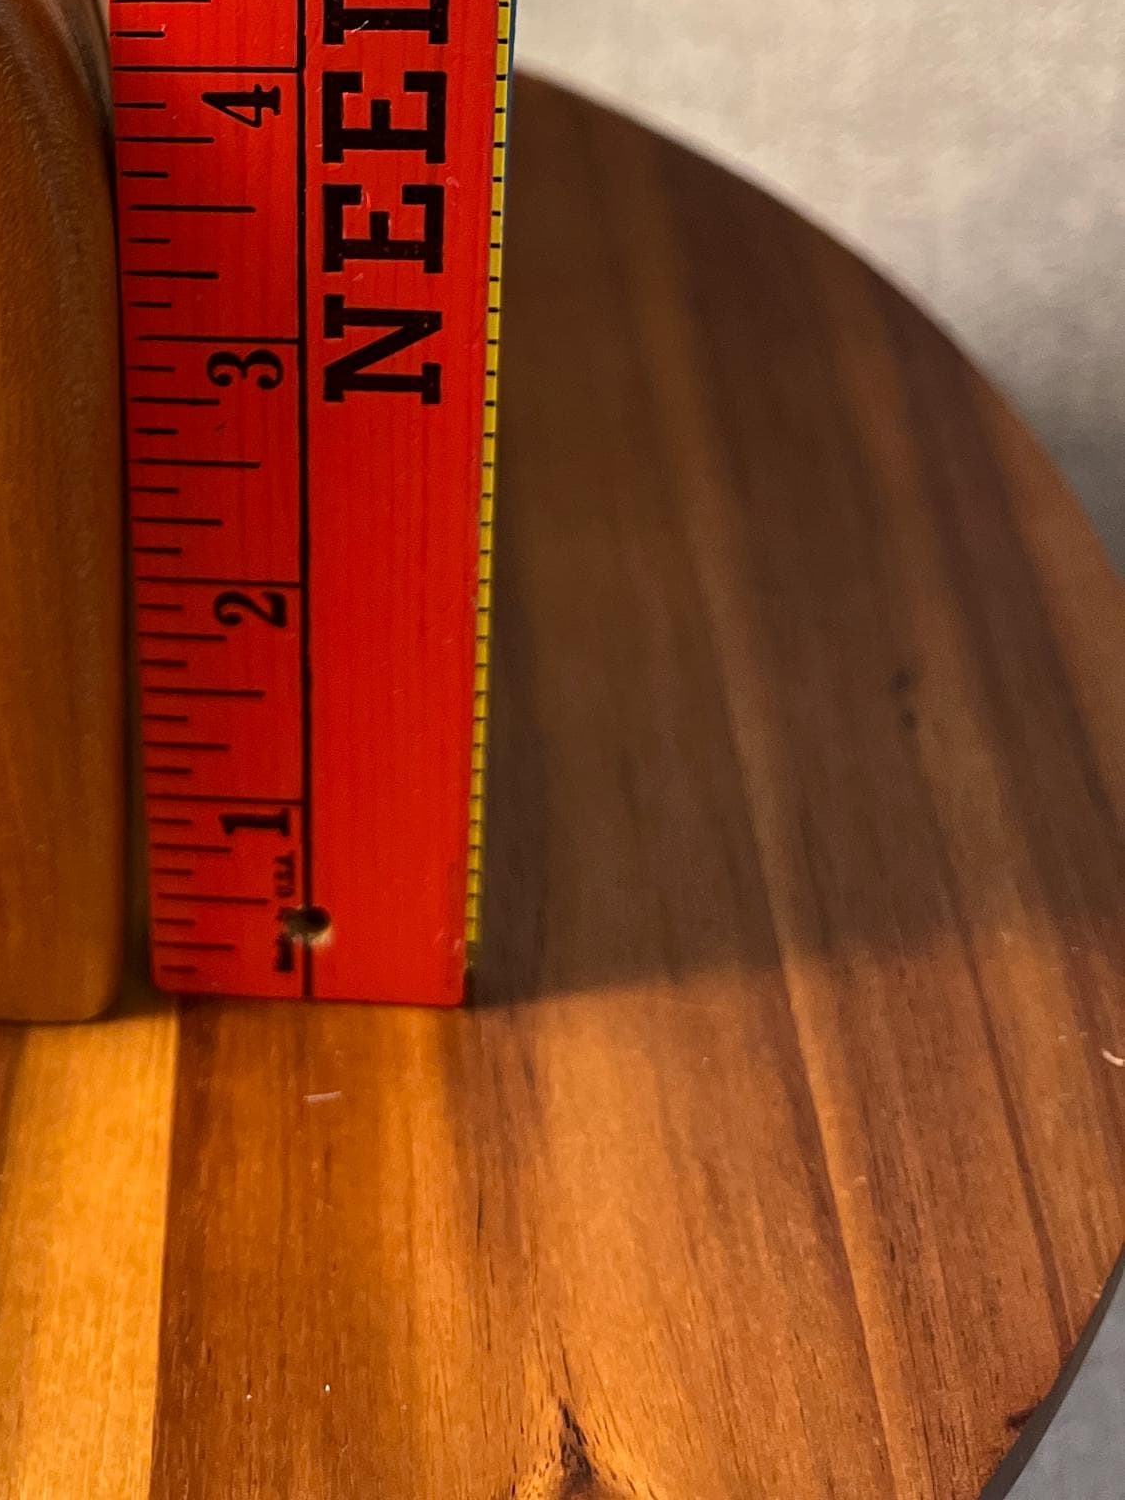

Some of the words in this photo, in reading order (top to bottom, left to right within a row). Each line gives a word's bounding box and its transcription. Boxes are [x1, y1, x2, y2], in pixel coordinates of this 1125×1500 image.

[201, 84, 281, 129] 4
[205, 348, 285, 391] 3
[214, 591, 287, 628] 2
[219, 809, 290, 838] 1
